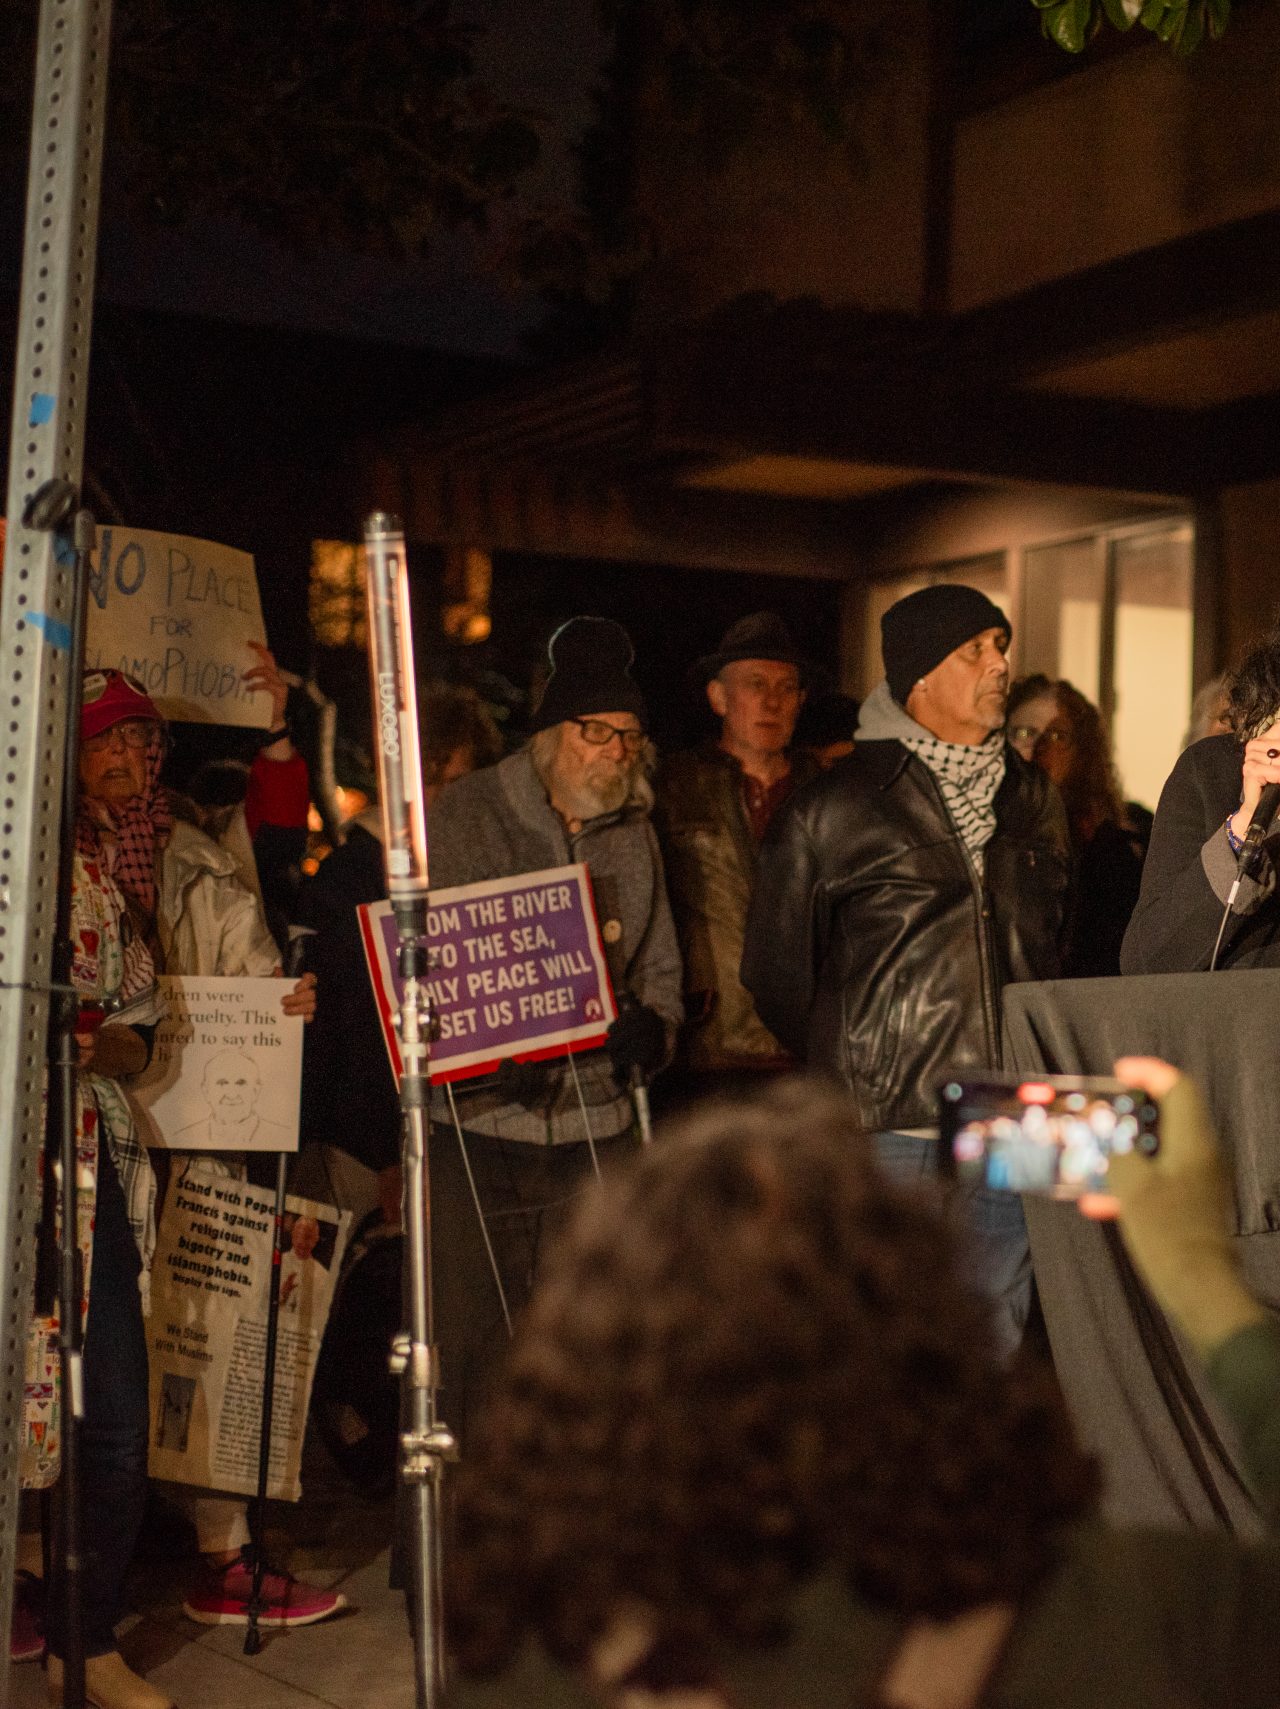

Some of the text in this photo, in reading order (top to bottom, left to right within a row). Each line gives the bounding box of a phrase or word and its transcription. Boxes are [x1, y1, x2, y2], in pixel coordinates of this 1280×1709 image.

[89, 529, 252, 615] NO PLACE
[150, 615, 192, 638] FOR
[426, 886, 572, 937] OM THE RIVER
[464, 932, 507, 963] THE
[511, 925, 555, 954] SEA,
[206, 991, 244, 1002] were
[420, 951, 592, 1007] NLY PEACE WILL
[179, 1009, 236, 1026] cruelty.
[242, 1010, 276, 1025] This
[440, 987, 576, 1040] SET US FREE!
[201, 1033, 217, 1045] to
[223, 1034, 246, 1048] say
[253, 1032, 281, 1046] this
[176, 1178, 277, 1215] Stand with Pope
[176, 1195, 269, 1232] Francis against
[178, 1235, 250, 1265] bigotry and
[190, 1222, 244, 1245] religious
